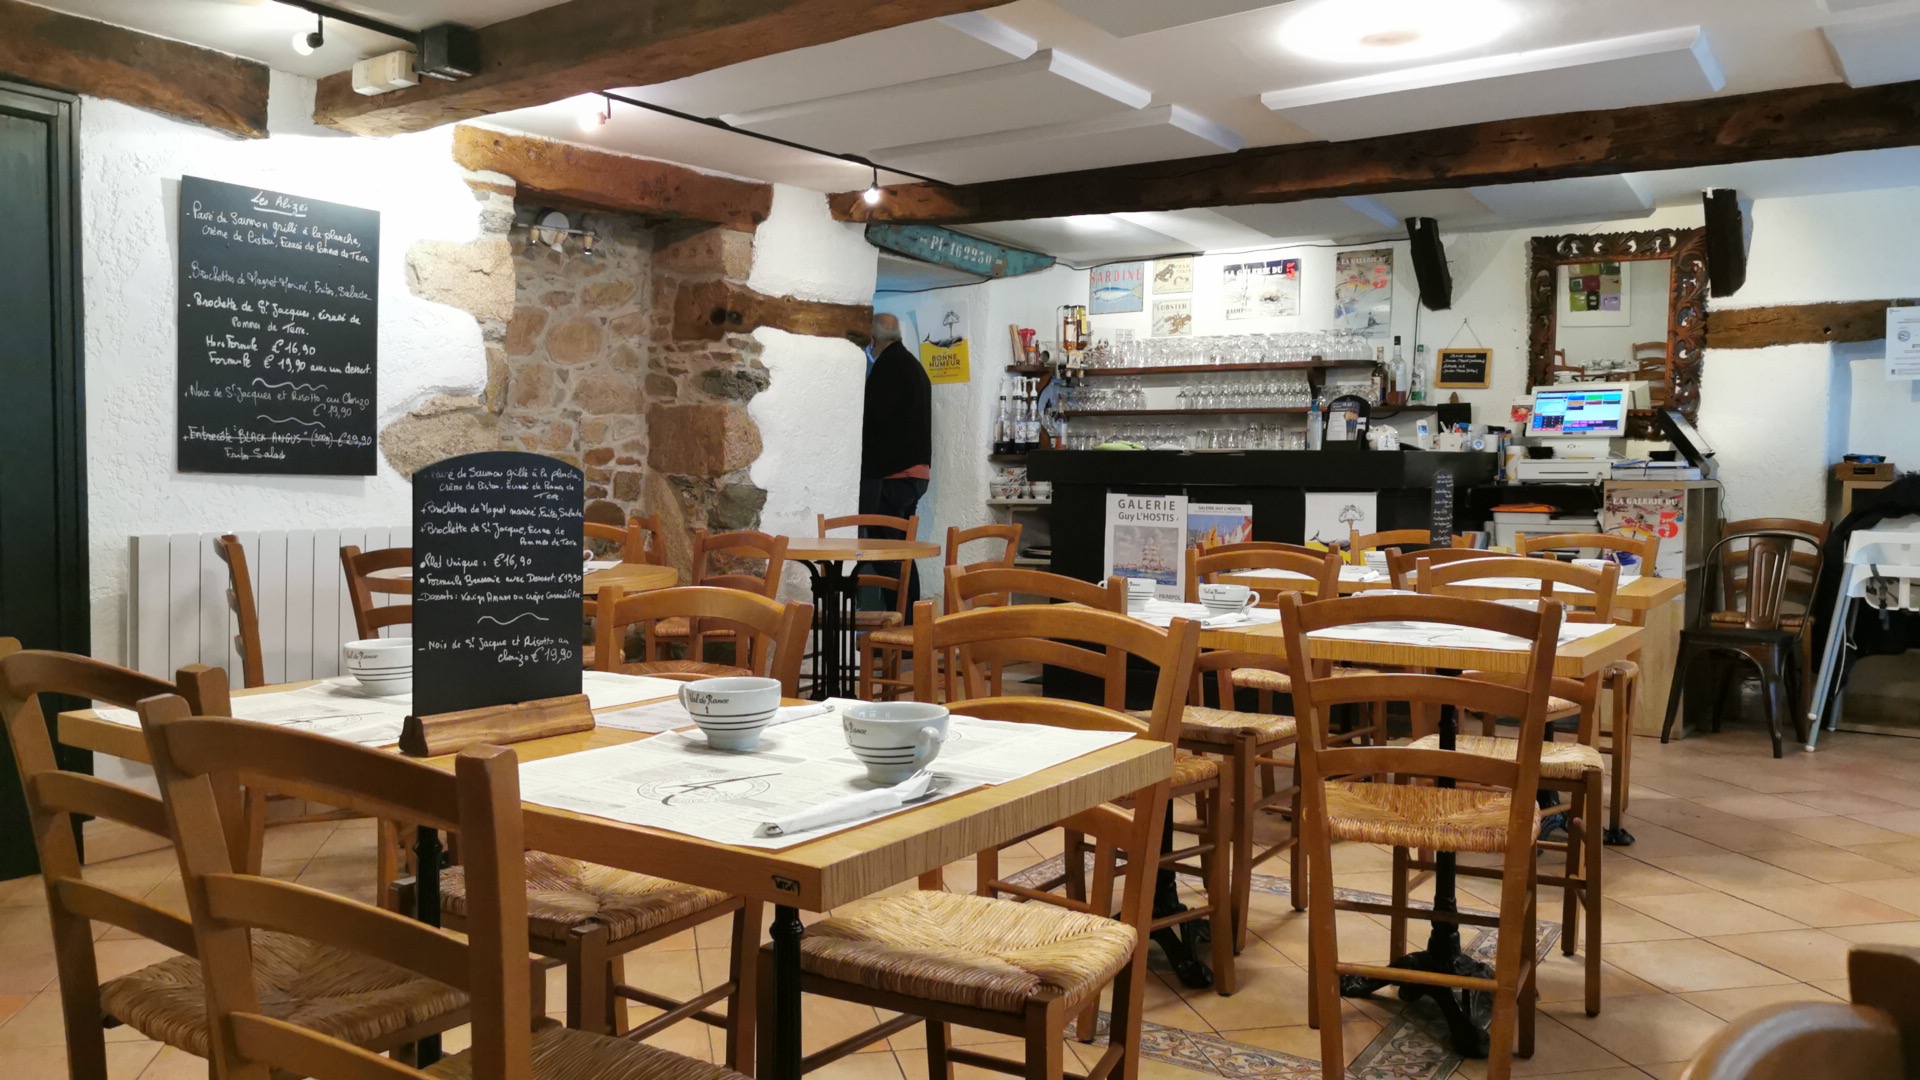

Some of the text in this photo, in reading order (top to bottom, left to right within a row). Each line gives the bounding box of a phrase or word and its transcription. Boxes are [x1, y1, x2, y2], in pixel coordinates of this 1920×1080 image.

[251, 191, 268, 205] Les
[312, 226, 322, 239] la
[233, 231, 243, 242] de
[305, 242, 315, 251] de
[1090, 268, 1142, 285] SARDINE
[1272, 265, 1282, 274] DU
[1286, 262, 1297, 280] 5
[237, 273, 246, 285] de
[1373, 267, 1388, 289] 5
[241, 301, 253, 311] de
[1157, 303, 1187, 311] LOBSTER
[267, 319, 277, 331] de
[208, 351, 252, 369] Formule
[932, 353, 957, 361] BONNE
[929, 359, 961, 368] HUMEUR
[213, 388, 222, 397] de
[277, 390, 287, 401] et
[457, 470, 466, 479] de
[540, 469, 547, 477] la
[465, 482, 474, 490] de
[1118, 499, 1175, 511] GALERIE
[1613, 497, 1624, 505] LA
[1626, 497, 1664, 505] GALERIE
[470, 504, 479, 513] de
[1118, 511, 1175, 522] Guy L'HOSTIS
[471, 523, 479, 533] de
[1658, 511, 1679, 539] 5
[551, 538, 560, 546] de
[452, 639, 461, 649] de
[512, 636, 520, 646] et
[689, 692, 699, 704] Val
[706, 694, 730, 705] Rance
